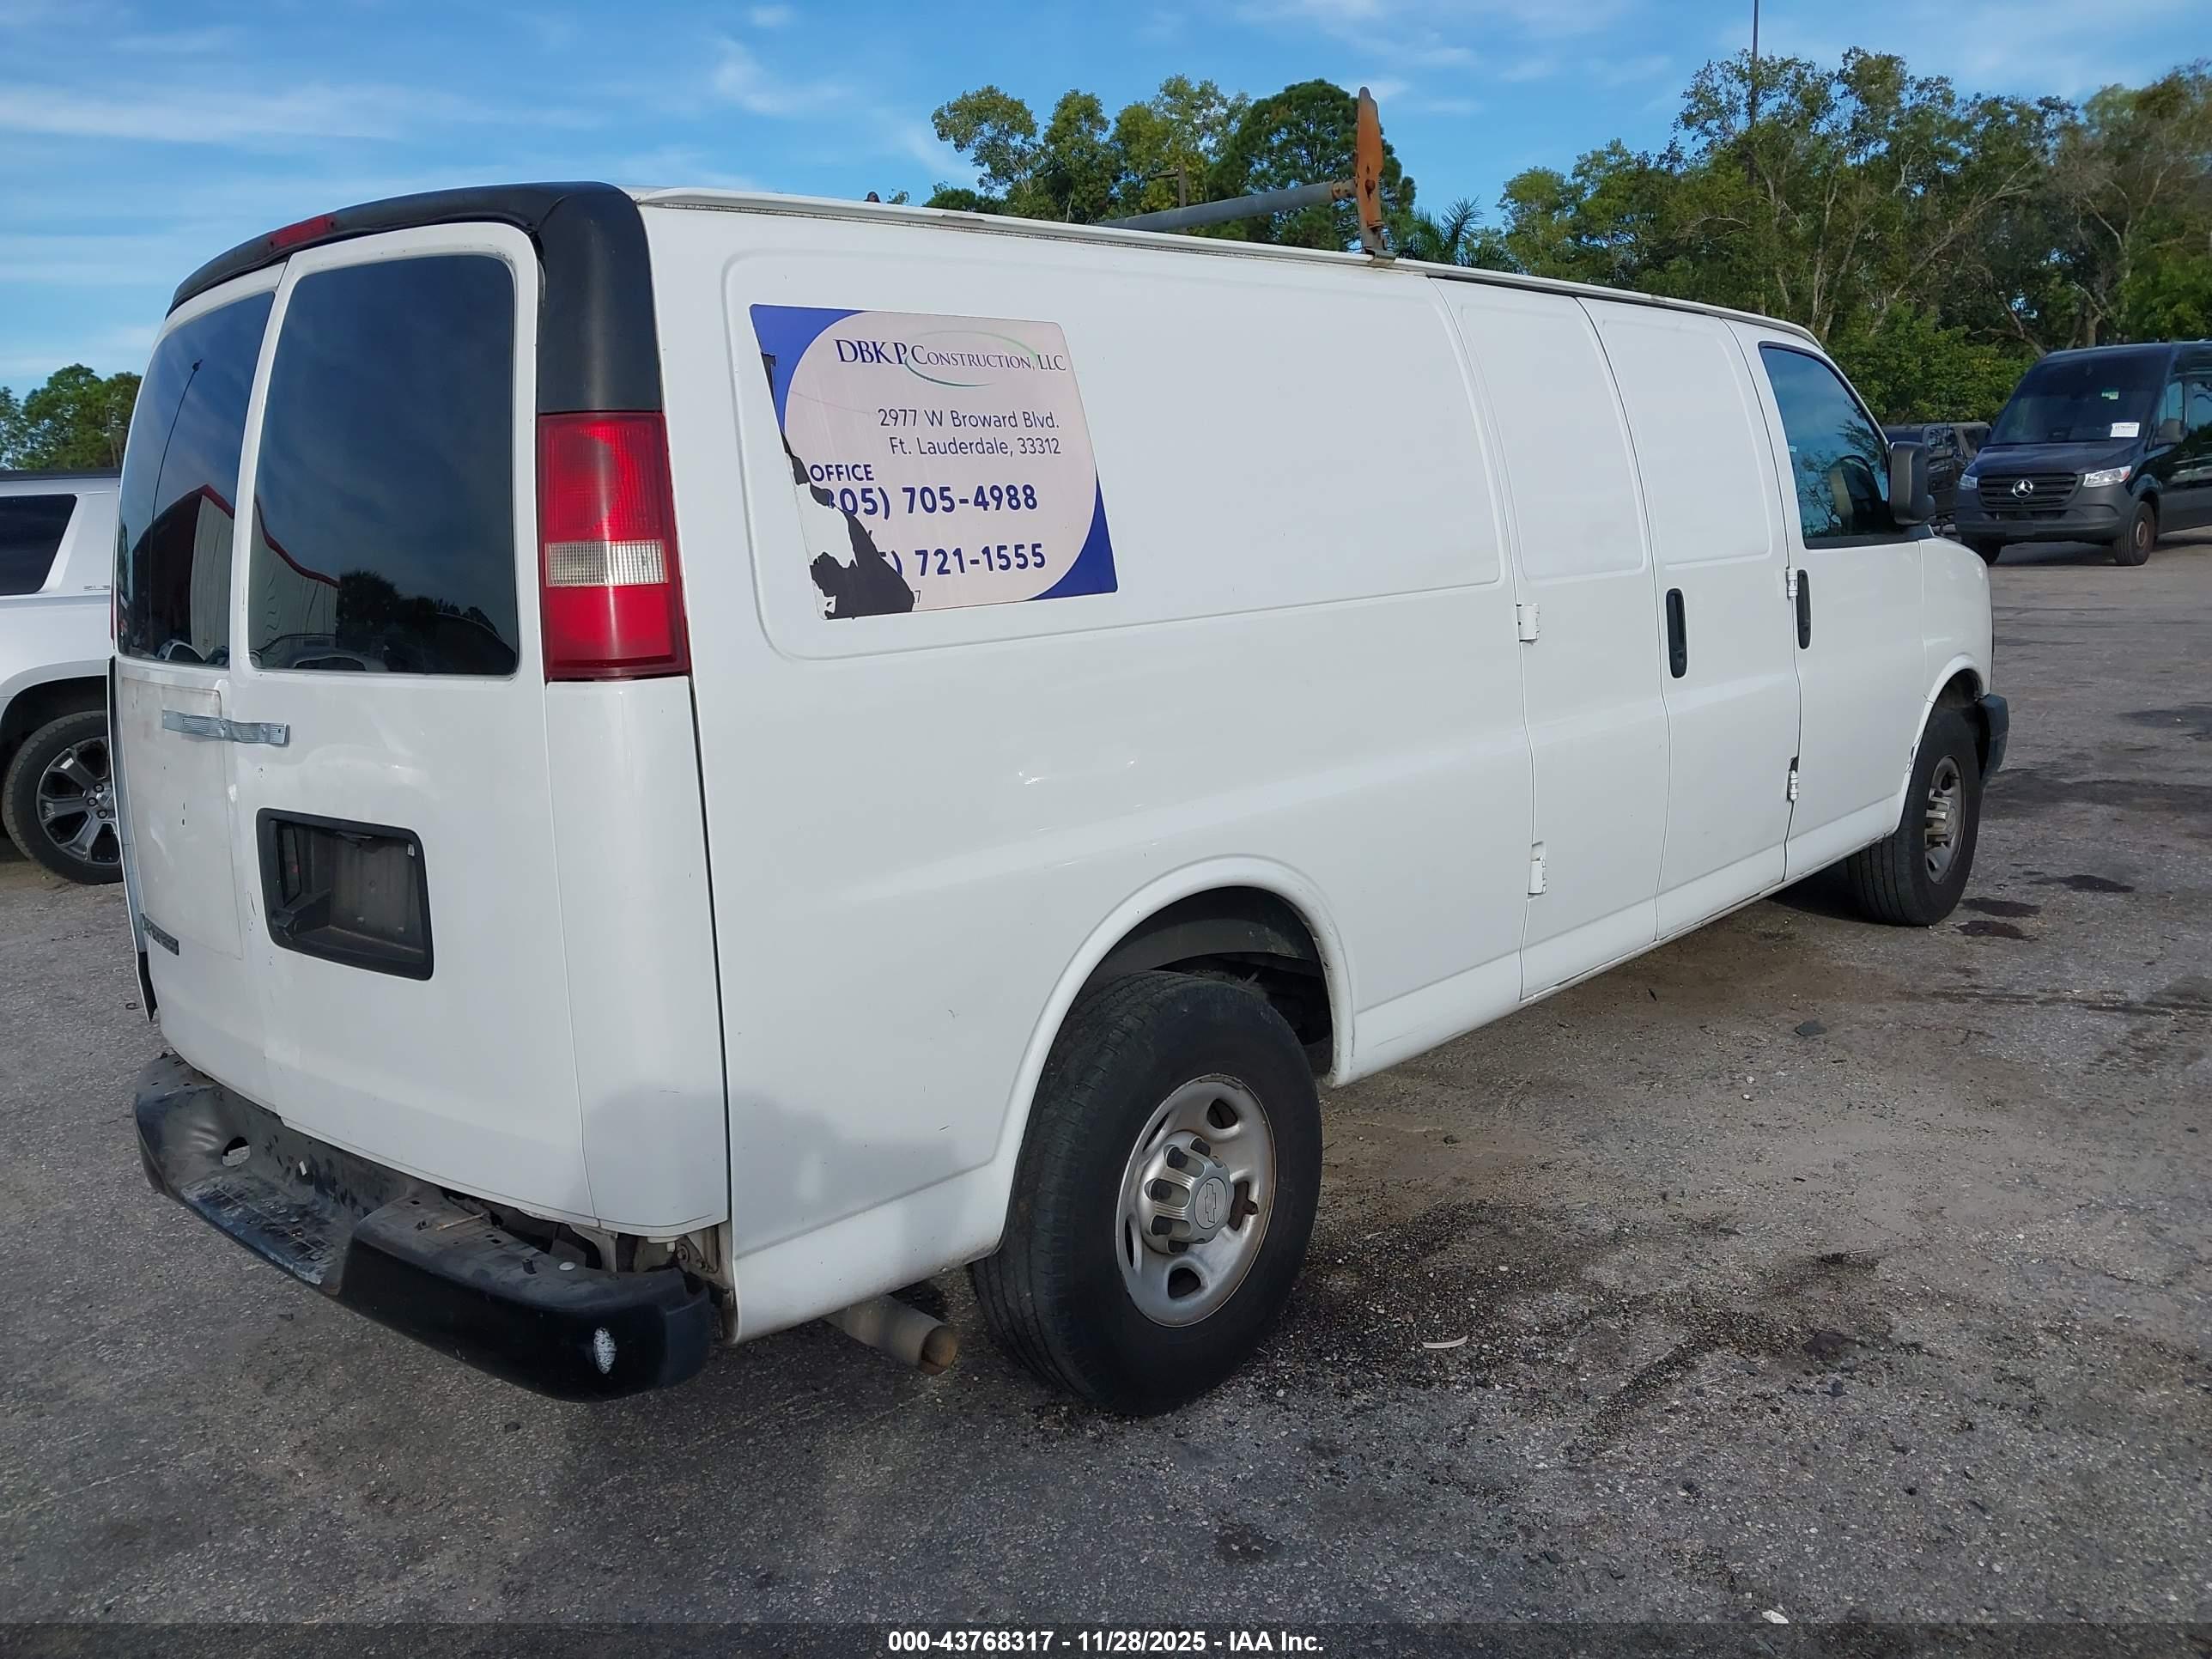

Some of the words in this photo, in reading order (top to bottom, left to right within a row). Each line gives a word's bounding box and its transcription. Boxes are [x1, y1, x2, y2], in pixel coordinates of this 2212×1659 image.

[1037, 354, 1066, 371] LLC
[878, 409, 917, 427] 2977
[924, 410, 944, 427] W
[951, 410, 1018, 428] Broward
[1022, 411, 1060, 428] Blvd.
[889, 437, 912, 455] Ft.
[916, 437, 1013, 458] Lauderdale,
[1017, 437, 1061, 454] 33312
[810, 464, 875, 482] OFFICE
[902, 484, 1037, 514] 705-4988
[915, 543, 1045, 576] 721-1555
